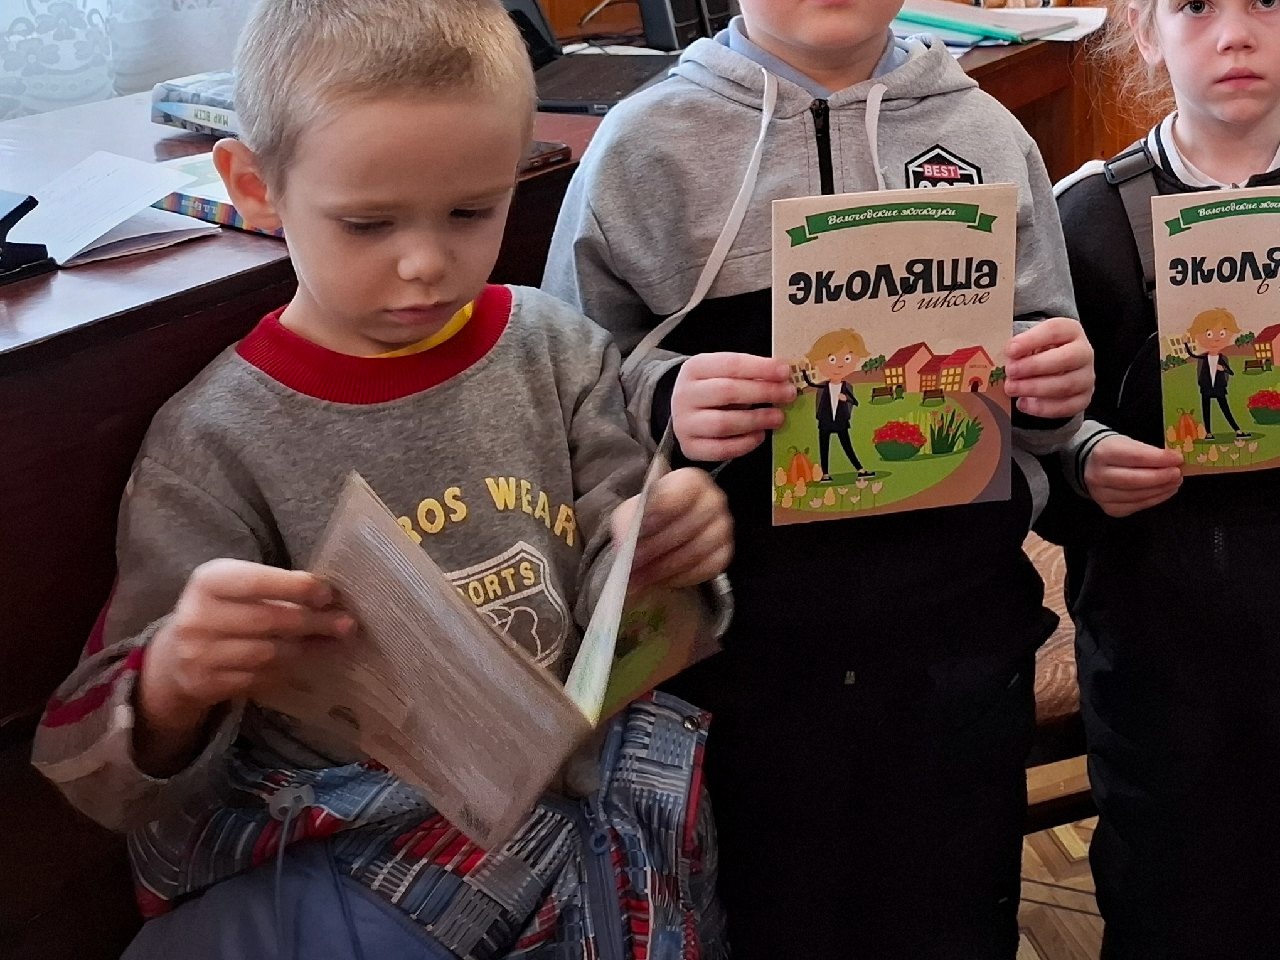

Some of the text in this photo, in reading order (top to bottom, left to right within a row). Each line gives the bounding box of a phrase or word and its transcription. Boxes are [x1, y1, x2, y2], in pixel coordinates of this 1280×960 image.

[924, 164, 957, 178] BEST
[827, 209, 899, 225] Вологодские
[1198, 202, 1258, 217] Вологодские
[917, 282, 991, 311] школе
[484, 477, 576, 547] WEAR
[457, 562, 535, 605] ORTS
